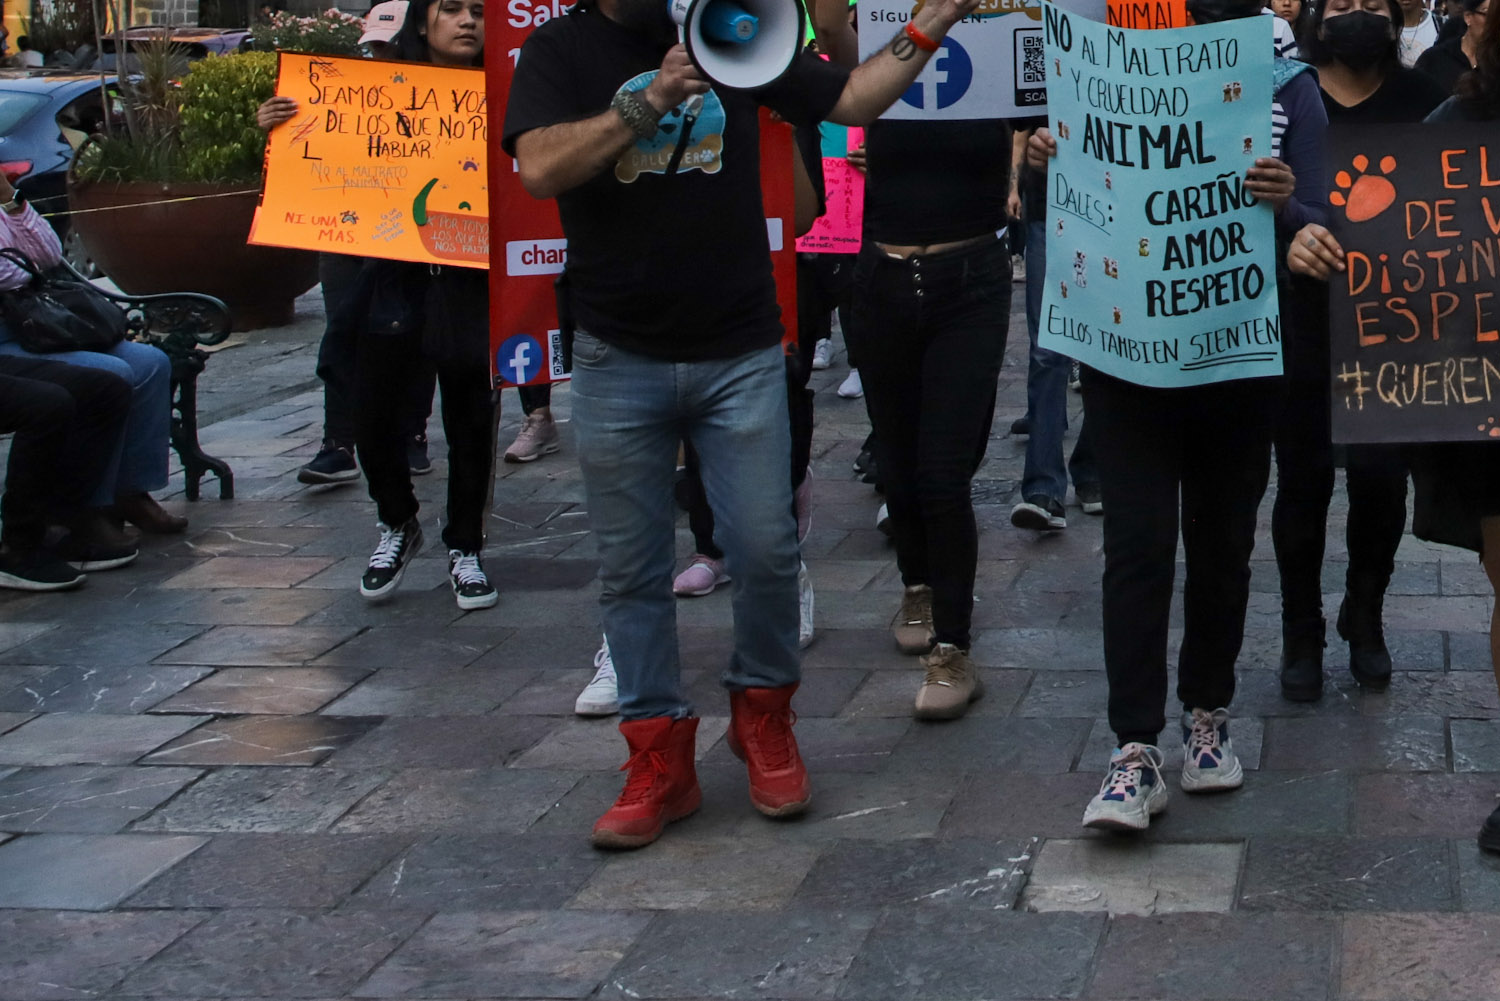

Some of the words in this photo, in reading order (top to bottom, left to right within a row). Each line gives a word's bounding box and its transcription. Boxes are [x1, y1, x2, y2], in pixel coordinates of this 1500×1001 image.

[870, 9, 914, 23] SÍGU
[1045, 3, 1073, 53] NO
[1081, 35, 1100, 67] AL
[1107, 28, 1239, 77] MALTRATO
[405, 86, 439, 111] LA
[1071, 67, 1081, 102] Y
[1087, 75, 1189, 118] CRUELDAD
[326, 109, 348, 133] DE
[356, 114, 390, 135] LOS
[396, 111, 431, 138] QUE
[440, 114, 465, 139] NO
[1082, 113, 1216, 170] ANIMAL
[285, 212, 306, 225] NI
[311, 215, 338, 228] UNA
[1405, 198, 1462, 240] DE
[1162, 221, 1253, 272] AMOR
[1145, 264, 1265, 318] RESPETO
[1098, 327, 1179, 364] TAMBIEN
[1190, 314, 1280, 361] SIENTEN
